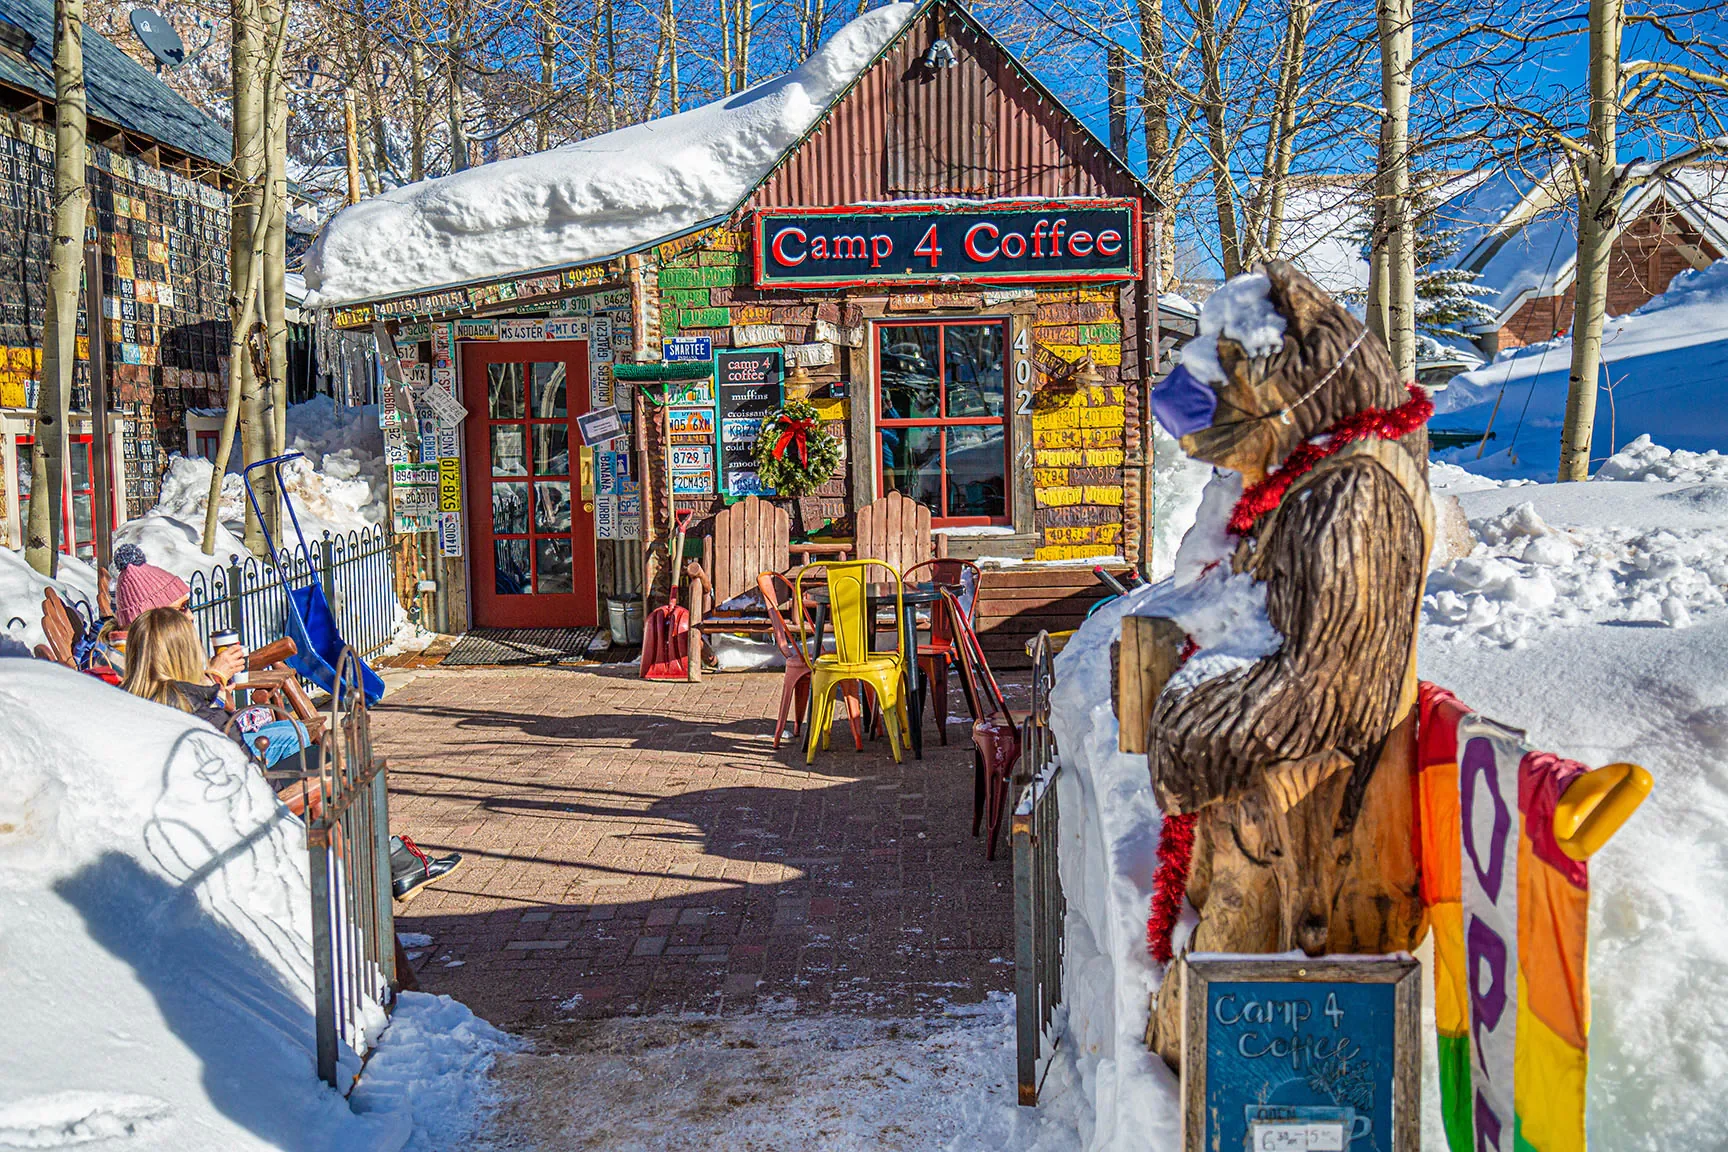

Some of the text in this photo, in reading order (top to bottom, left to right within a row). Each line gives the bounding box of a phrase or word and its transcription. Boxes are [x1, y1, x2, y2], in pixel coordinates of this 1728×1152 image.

[772, 227, 893, 268] Camp
[913, 224, 943, 268] 4
[965, 218, 1123, 263] Coffee
[669, 343, 706, 356] SMARTEE
[727, 357, 771, 372] camp 4
[728, 369, 765, 381] coffee
[731, 389, 769, 401] muffins
[725, 442, 745, 452] cold
[673, 451, 700, 465] 8729
[600, 455, 612, 491] BANANA
[599, 496, 611, 538] TURBO 22
[1214, 991, 1346, 1033] Camp 4
[1238, 1033, 1361, 1070] Coffee
